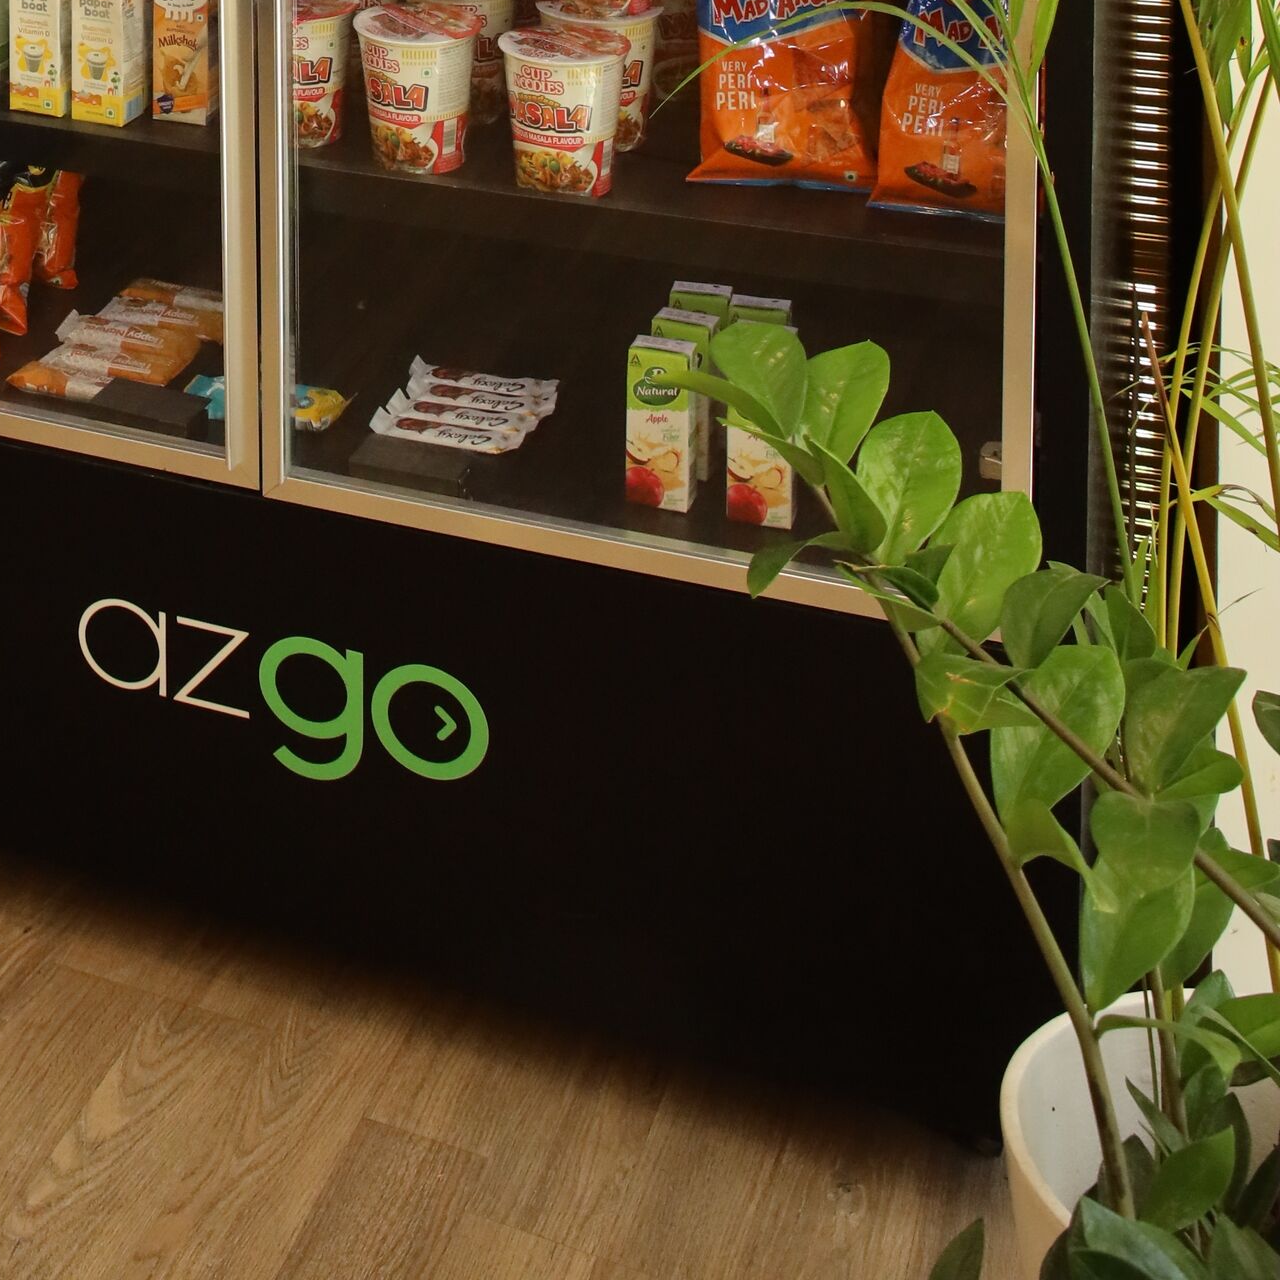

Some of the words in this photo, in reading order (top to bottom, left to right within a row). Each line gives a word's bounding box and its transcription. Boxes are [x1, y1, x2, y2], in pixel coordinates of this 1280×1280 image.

[22, 0, 47, 12] boat
[85, 7, 110, 19] boat
[18, 27, 44, 36] Vitamin
[521, 65, 552, 80] CUP
[722, 61, 747, 72] VERY
[514, 74, 564, 95] NOODLES
[720, 73, 751, 89] PERI
[298, 88, 324, 97] FLAVOUR
[915, 83, 941, 97] VERY
[716, 91, 756, 110] PERI
[908, 96, 944, 114] PERI
[392, 114, 419, 123] FLAVOUR
[529, 133, 552, 144] MASALA
[552, 137, 582, 145] FLAVOUR
[636, 386, 677, 397] Natural
[646, 413, 668, 424] Apple
[78, 598, 491, 781] azgo
